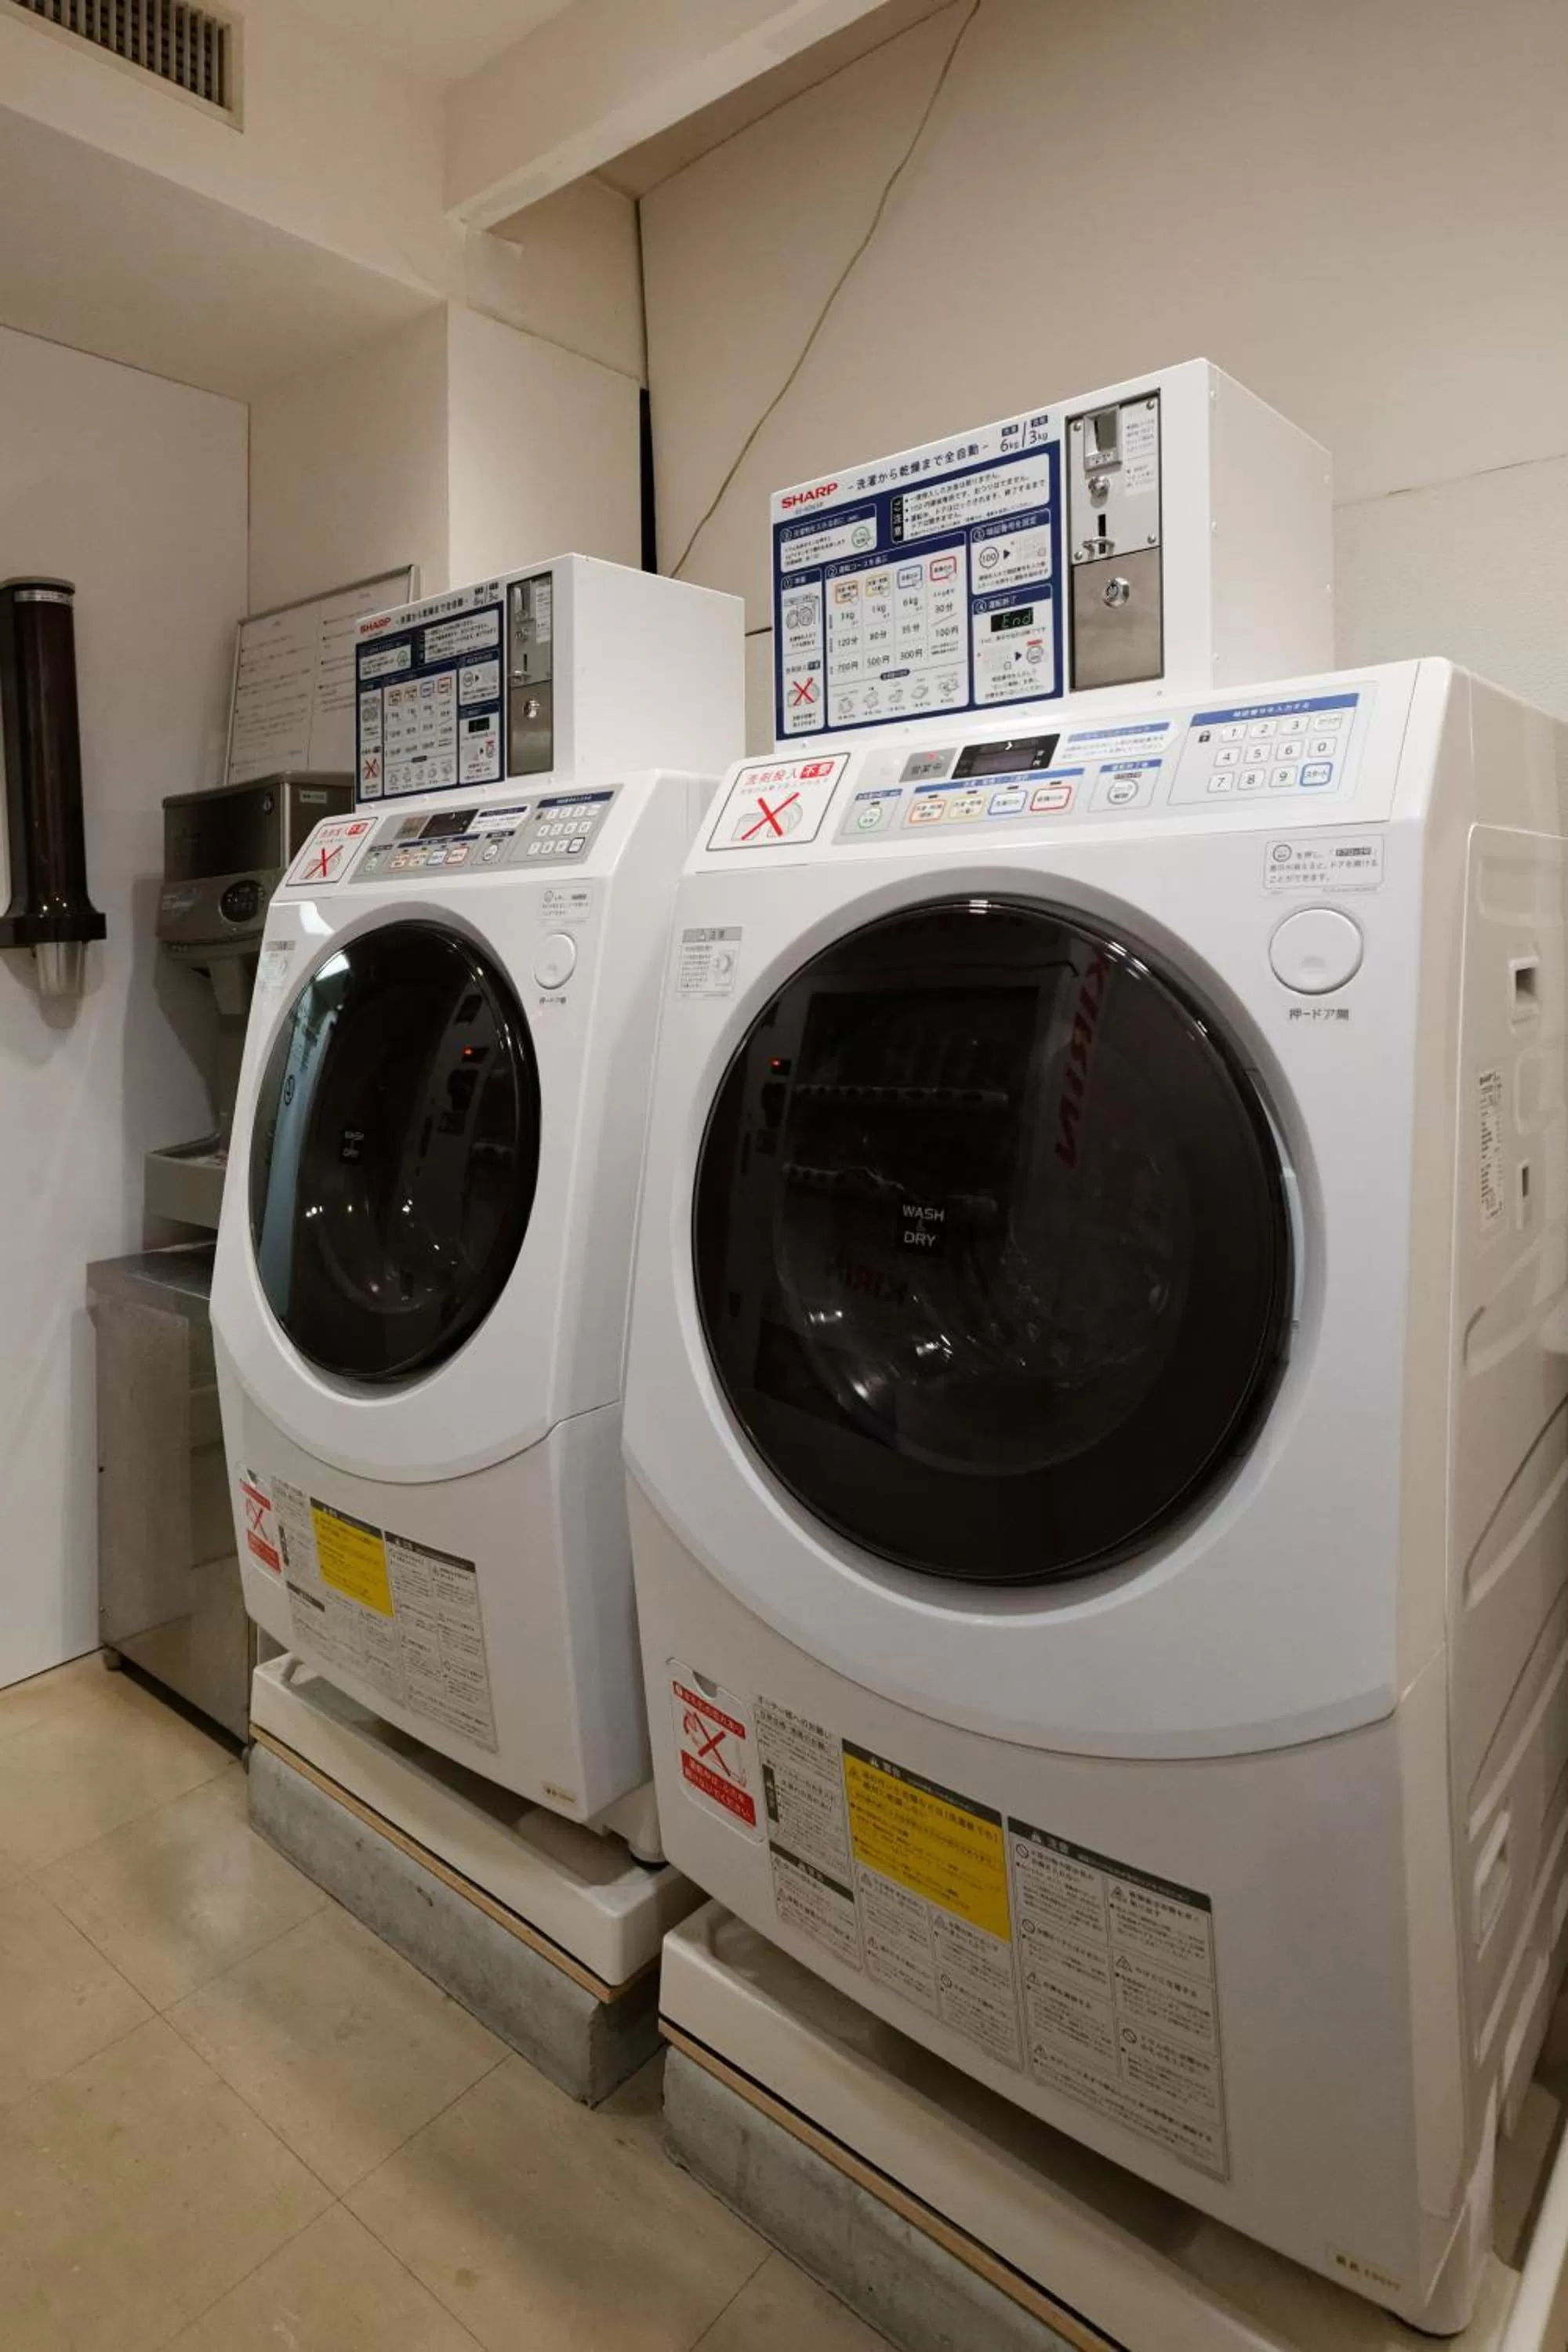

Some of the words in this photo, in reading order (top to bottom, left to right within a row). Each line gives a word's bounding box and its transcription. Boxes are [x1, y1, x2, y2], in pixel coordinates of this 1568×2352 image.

[781, 482, 838, 509] SHARP
[360, 618, 391, 633] SHARP
[1002, 612, 1031, 629] End
[902, 1203, 945, 1224] WASH
[903, 1230, 938, 1248] DRY
